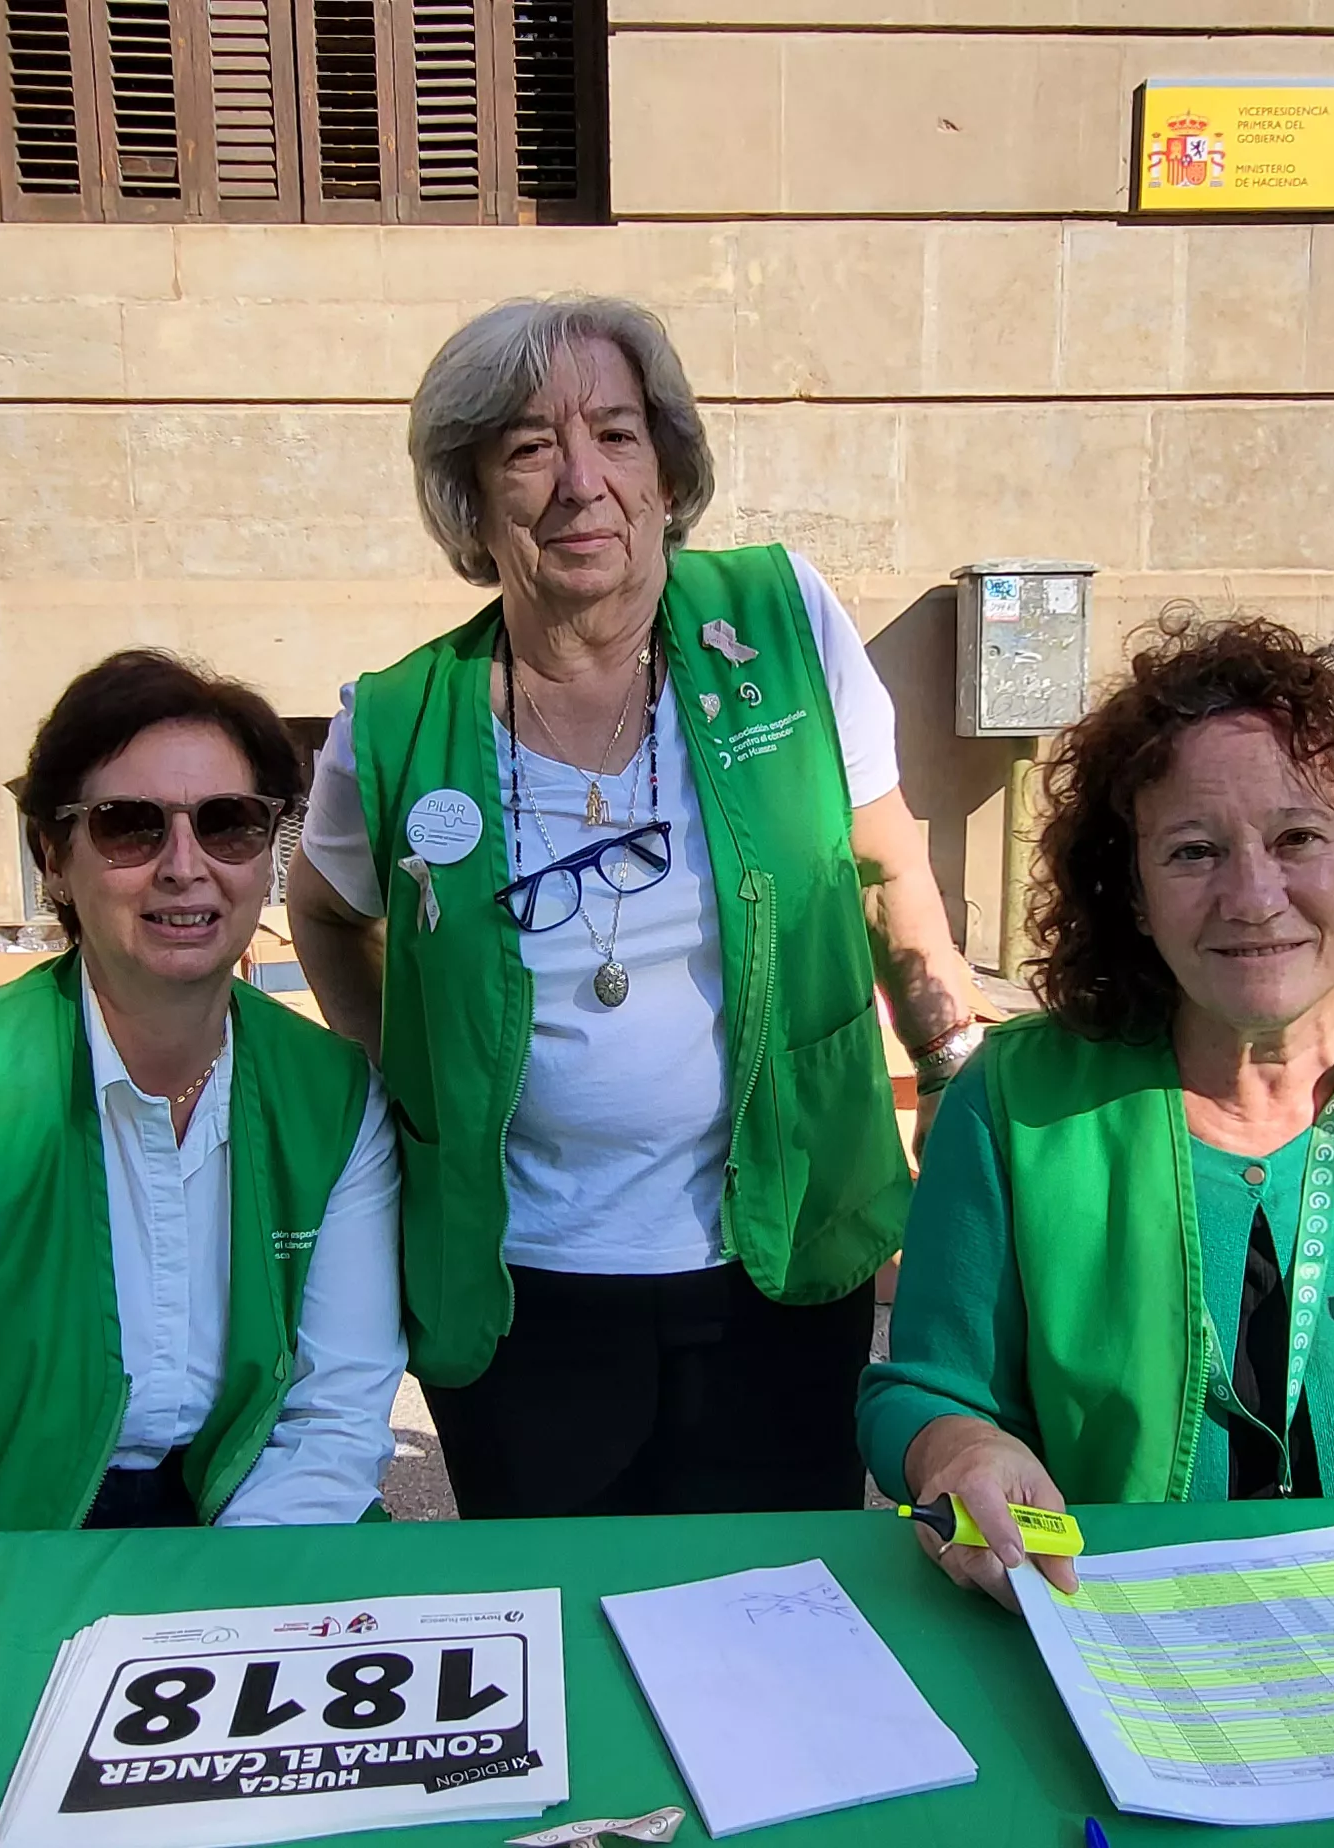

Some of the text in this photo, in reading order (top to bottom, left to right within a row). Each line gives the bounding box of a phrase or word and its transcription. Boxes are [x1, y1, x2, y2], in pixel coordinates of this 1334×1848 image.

[1238, 106, 1330, 116] VICEPRESIDENCIA
[1237, 120, 1305, 130] PRIMERA DEL
[1236, 134, 1295, 144] GOBIERNO
[1235, 164, 1296, 174] MINISTERIO
[1234, 177, 1309, 188] DE HACIENDA
[427, 799, 466, 816] PILAR
[113, 1647, 509, 1746] 1818
[99, 1733, 503, 1787] CONTRA EL CÁNCER
[435, 1754, 531, 1788] XI EDICIÓN
[239, 1768, 360, 1795] HUESCA
